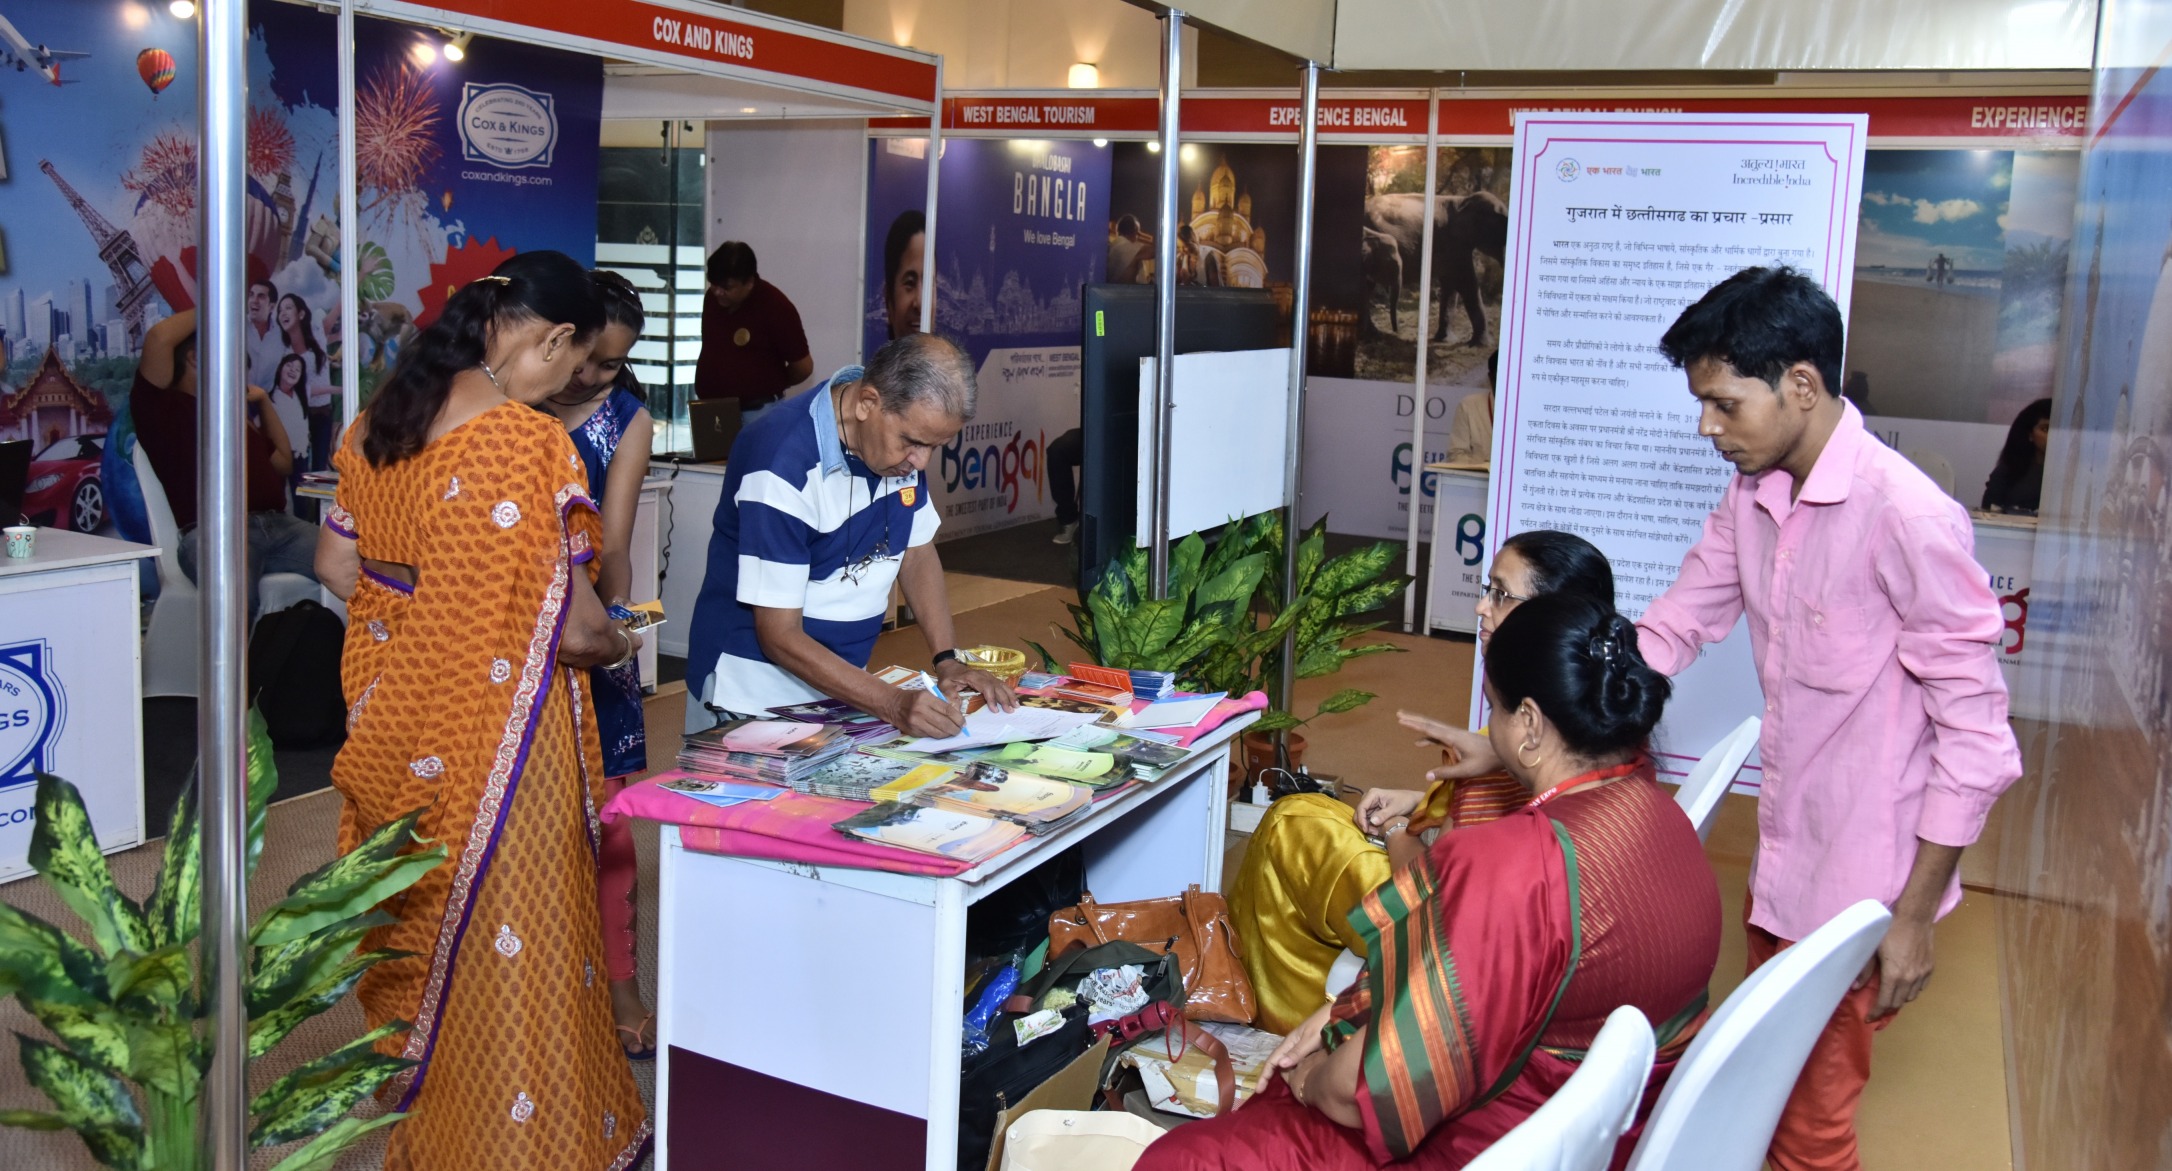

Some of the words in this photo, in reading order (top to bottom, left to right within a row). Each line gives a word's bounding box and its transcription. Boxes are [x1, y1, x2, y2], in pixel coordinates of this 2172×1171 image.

[653, 16, 682, 45] COX
[683, 23, 712, 51] AND
[714, 30, 754, 60] KINGS
[963, 106, 994, 123] WEST
[996, 106, 1041, 124] BENGAL
[1043, 106, 1095, 124] TOURISM
[1269, 107, 1351, 126] EXPEENCE
[1353, 107, 1407, 127] BENGAL
[1971, 106, 2086, 128] EXPERIENCE
[498, 122, 507, 132] &
[509, 120, 545, 136] KINGS
[461, 171, 553, 186] coxandkings.com
[1602, 167, 1623, 176] भारत
[1641, 168, 1662, 177] भारत
[1013, 171, 1087, 222] BANGLA
[1565, 207, 1609, 222] गुजरात
[1610, 204, 1623, 219] में
[1689, 210, 1709, 223] का
[1712, 211, 1747, 224] प्रचार
[1023, 229, 1036, 244] We
[1036, 230, 1051, 245] love
[1052, 231, 1076, 250] Bengal
[1553, 240, 1569, 248] भारत
[1571, 241, 1582, 250] एक
[1711, 243, 1723, 255] और
[1590, 257, 1610, 268] विकास
[1619, 276, 1631, 287] और
[1560, 308, 1572, 318] और
[1546, 340, 1562, 348] समय
[1562, 338, 1574, 349] और
[1633, 342, 1645, 353] और
[1533, 354, 1544, 364] और
[1569, 358, 1584, 367] भारत
[1615, 359, 1627, 370] और
[1543, 404, 1561, 413] सरदार
[1594, 407, 1609, 417] पटेल
[965, 421, 1013, 443] EXPERIENCE
[1569, 423, 1588, 432] अवसर
[940, 426, 1046, 515] Bengal
[1658, 461, 1671, 472] और
[1547, 469, 1558, 480] और
[1614, 492, 1624, 502] और
[1462, 572, 1474, 584] THE
[1451, 590, 1480, 599] DEPARTM
